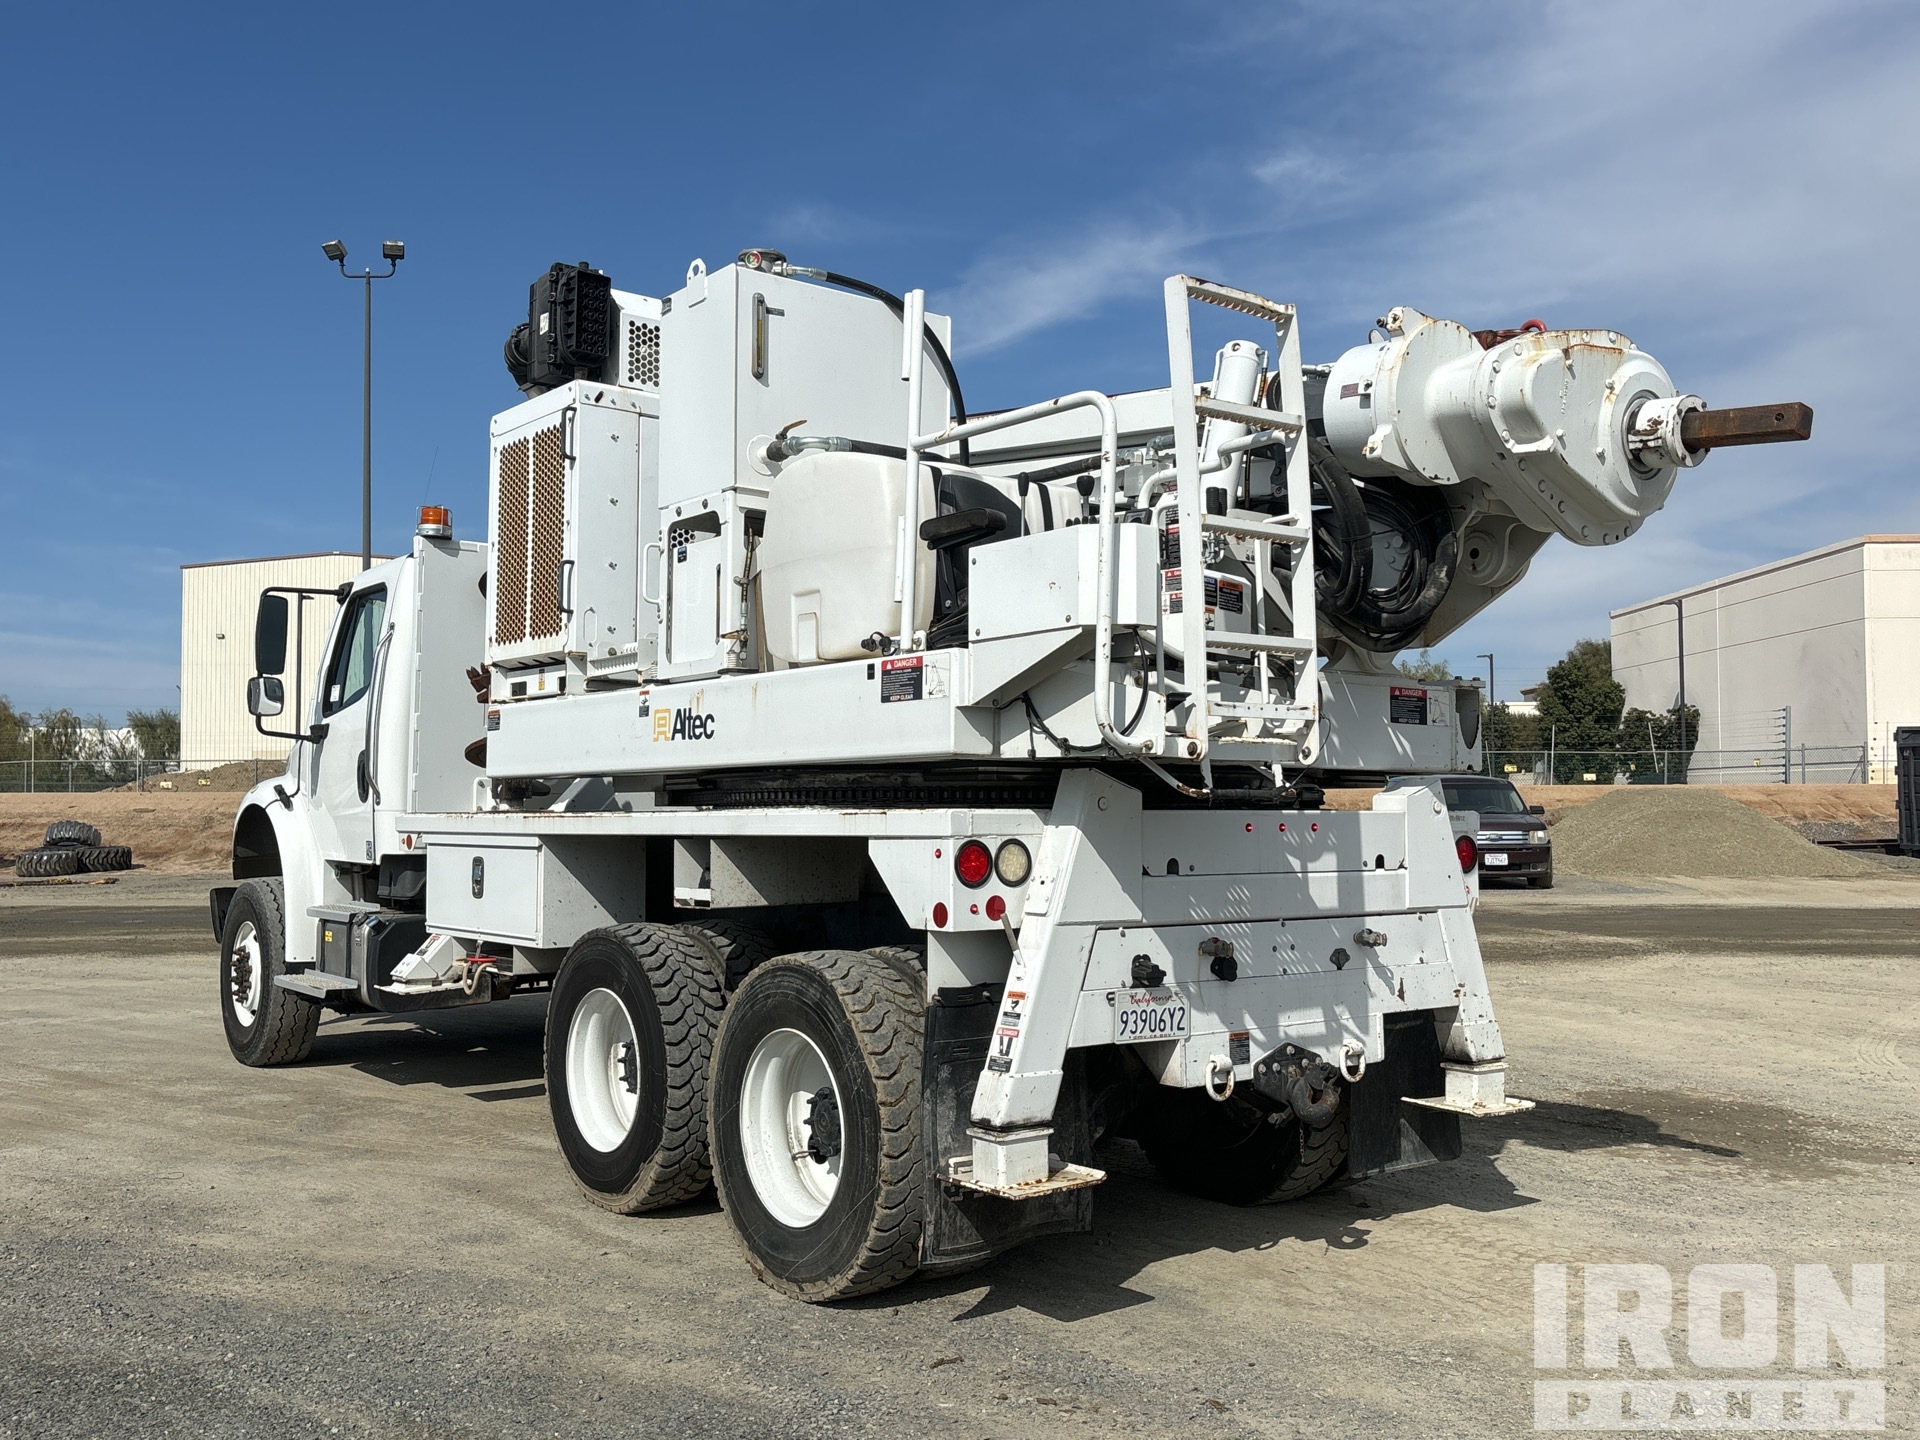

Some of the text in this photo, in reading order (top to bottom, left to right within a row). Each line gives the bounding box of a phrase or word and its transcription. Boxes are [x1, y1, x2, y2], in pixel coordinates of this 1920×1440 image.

[893, 658, 917, 668] DANGER
[1401, 689, 1423, 697] DANGER
[671, 707, 715, 741] Altec
[1130, 992, 1176, 1007] California
[1120, 1007, 1186, 1036] 93906Y2
